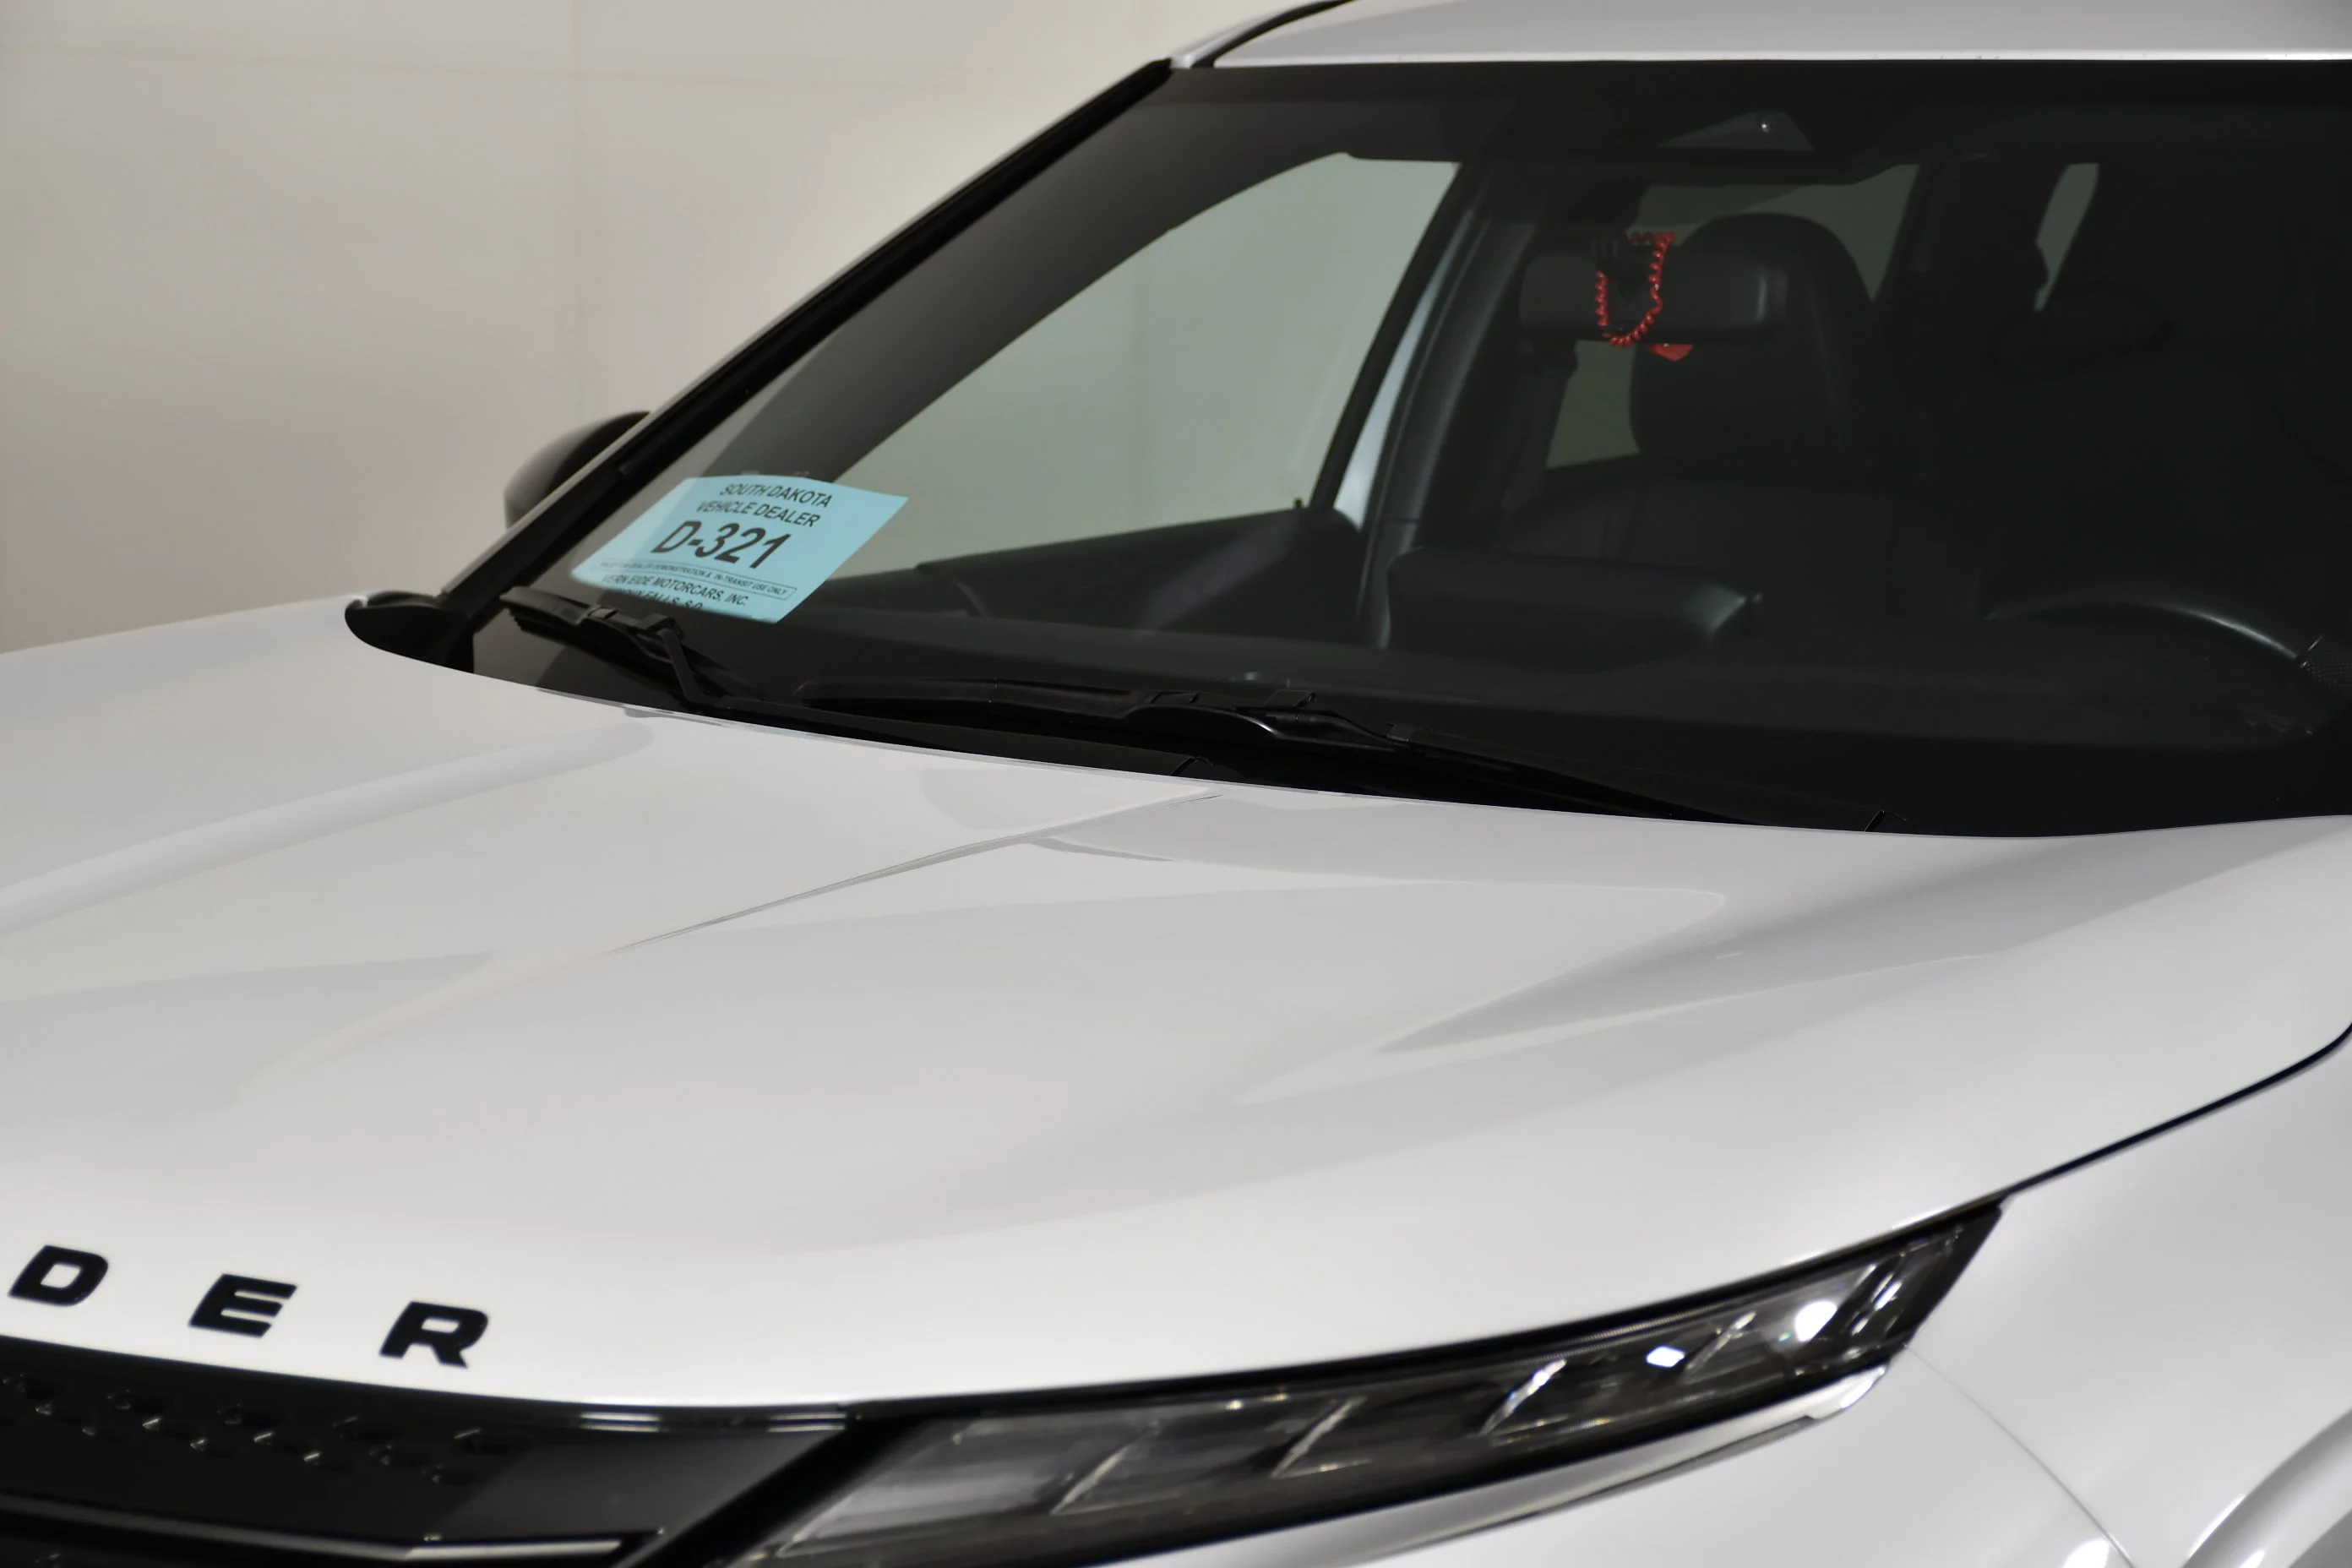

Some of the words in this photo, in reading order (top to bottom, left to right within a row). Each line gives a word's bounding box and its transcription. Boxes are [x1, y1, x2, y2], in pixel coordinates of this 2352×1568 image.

[719, 483, 768, 496] SOUTH
[766, 485, 833, 508] DAKOTA
[696, 500, 757, 514] VEHICLE
[754, 504, 821, 528] DEALER
[650, 520, 792, 569] D-321
[766, 586, 789, 596] ONLY
